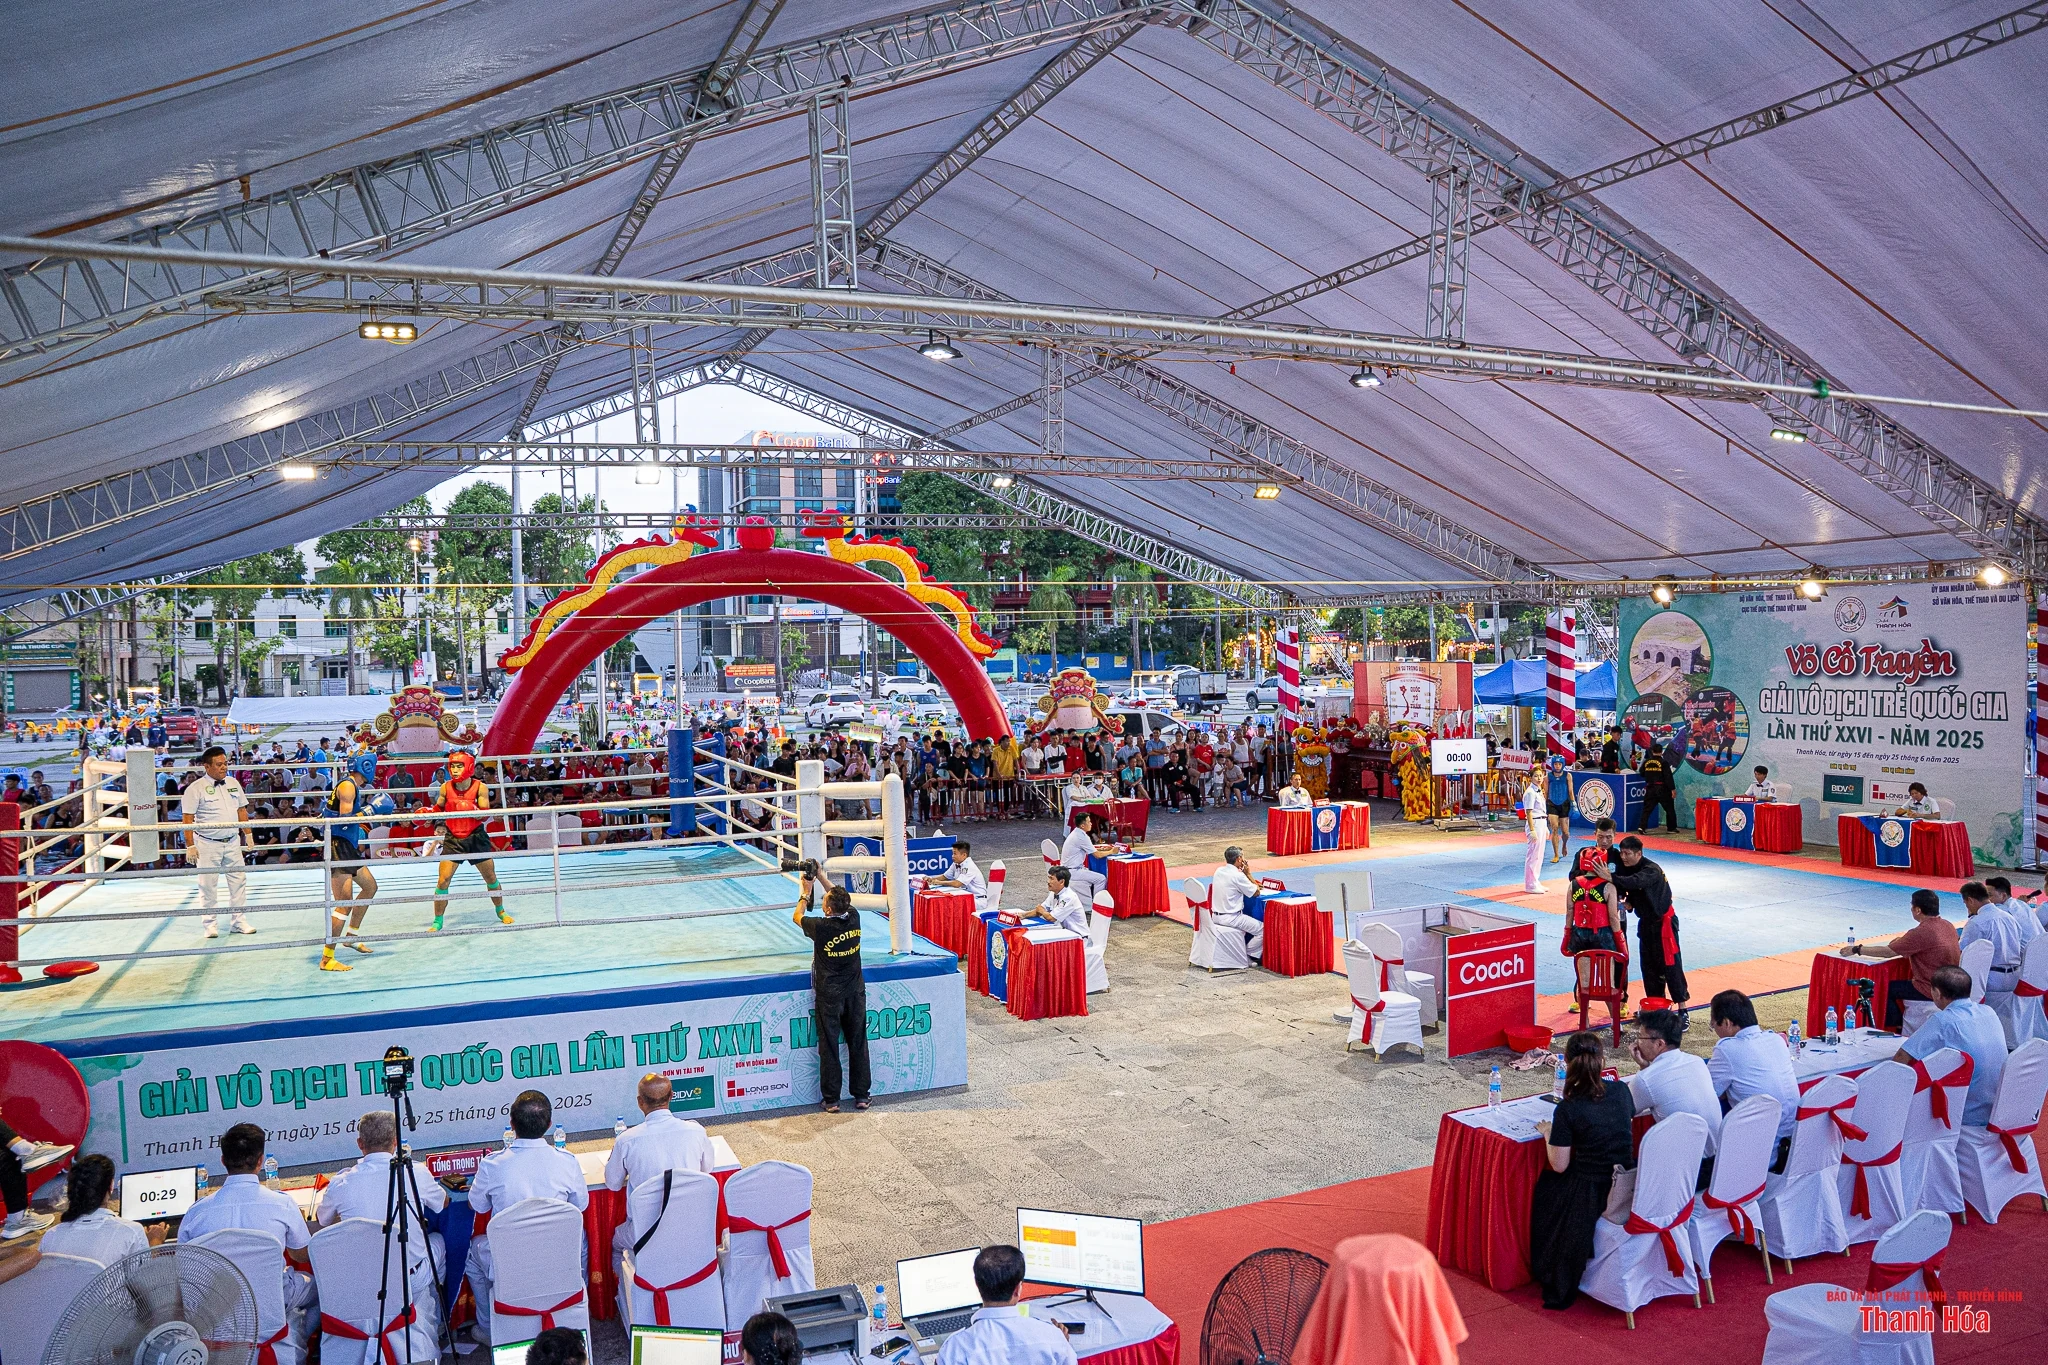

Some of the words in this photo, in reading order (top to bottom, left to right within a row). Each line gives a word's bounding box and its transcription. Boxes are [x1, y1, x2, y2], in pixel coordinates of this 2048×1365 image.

[1939, 585, 1950, 593] BAN
[1976, 596, 1989, 604] THAO
[1784, 643, 1819, 677] Võ
[1821, 639, 1857, 677] Cổ
[1857, 637, 1957, 685] Truyền
[1759, 681, 1793, 714] GIẢI
[1797, 682, 1822, 715] VÔ
[1823, 689, 1868, 721] ĐỊCH
[1871, 682, 1907, 718] TRẺ
[1910, 685, 1967, 721] QUỐC
[1970, 692, 2008, 721] GIA
[1767, 717, 1796, 740] LẦN
[1800, 720, 1832, 742] THỨ
[1835, 725, 1872, 744] XXVI
[1891, 724, 1930, 746] NĂM
[1936, 729, 1984, 749] 2025
[1446, 753, 1472, 762] 00:00
[1796, 748, 1814, 756] Thanh
[1814, 749, 1827, 757] Hóa,
[1828, 749, 1837, 757] từ
[1837, 751, 1852, 759] ngày
[1862, 751, 1874, 759] đến
[1875, 753, 1890, 761] ngày
[1900, 754, 1919, 763] tháng
[1925, 755, 1941, 763] năm
[1943, 756, 1960, 764] 2025
[1831, 784, 1848, 792] BIDV
[1885, 792, 1904, 800] LONG
[908, 855, 948, 872] oach
[1460, 953, 1524, 985] Coach
[139, 1067, 209, 1119] GIẢI
[216, 1063, 262, 1110] VÔ
[270, 1063, 348, 1110] ĐỊCH
[421, 1041, 504, 1091] QUỐC
[510, 1042, 562, 1079] GIA
[568, 1030, 626, 1074] LẦN
[632, 1021, 691, 1067] THỨ
[698, 1022, 763, 1059] XXVI
[770, 1035, 783, 1044] -
[866, 1002, 932, 1041] 2025
[683, 1066, 692, 1074] TÀI
[693, 1065, 705, 1075] TRỢ
[745, 1084, 769, 1094] LONG
[770, 1082, 789, 1091] SON
[143, 1136, 203, 1157] Thanh
[276, 1122, 320, 1144] ngày
[322, 1120, 341, 1136] 15
[424, 1109, 443, 1125] 25
[449, 1104, 496, 1124] tháng
[500, 1102, 510, 1116] 6
[554, 1093, 593, 1110] 2025
[432, 1155, 451, 1173] TỔNG
[452, 1157, 475, 1172] TRỌNG
[140, 1188, 177, 1203] 00:29
[724, 1341, 740, 1359] HƯ
